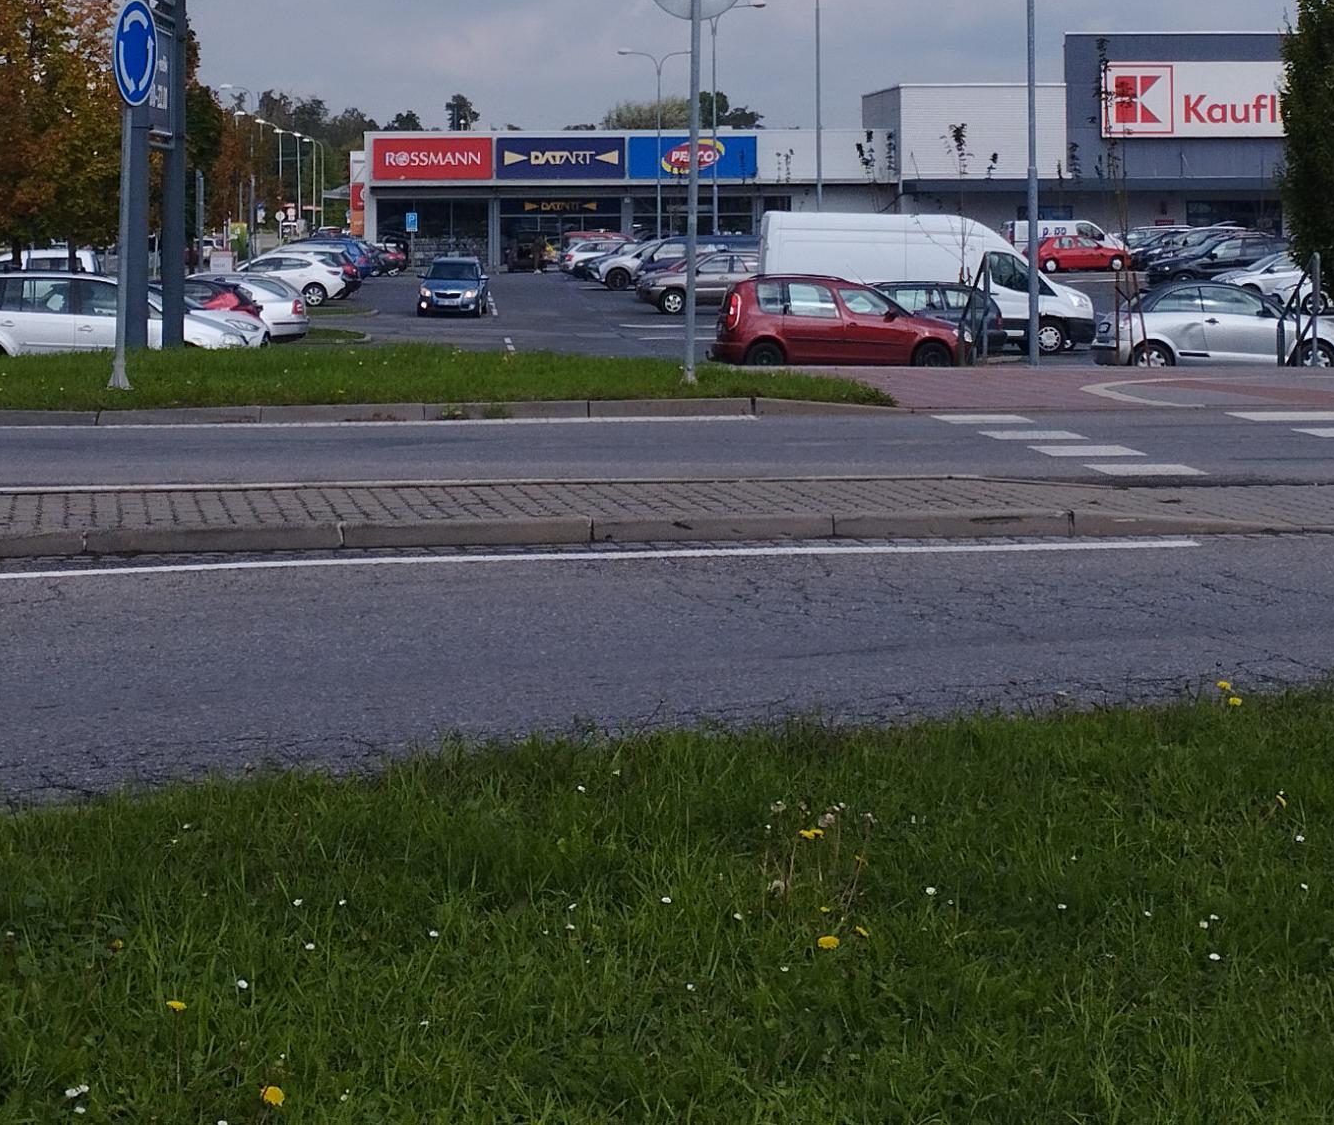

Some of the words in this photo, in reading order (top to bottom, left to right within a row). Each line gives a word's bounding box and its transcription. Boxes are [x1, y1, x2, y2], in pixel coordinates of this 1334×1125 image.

[1183, 94, 1282, 124] Kaufl
[385, 151, 481, 167] ROSSMANN
[530, 151, 596, 165] DATART
[671, 150, 715, 163] PECO
